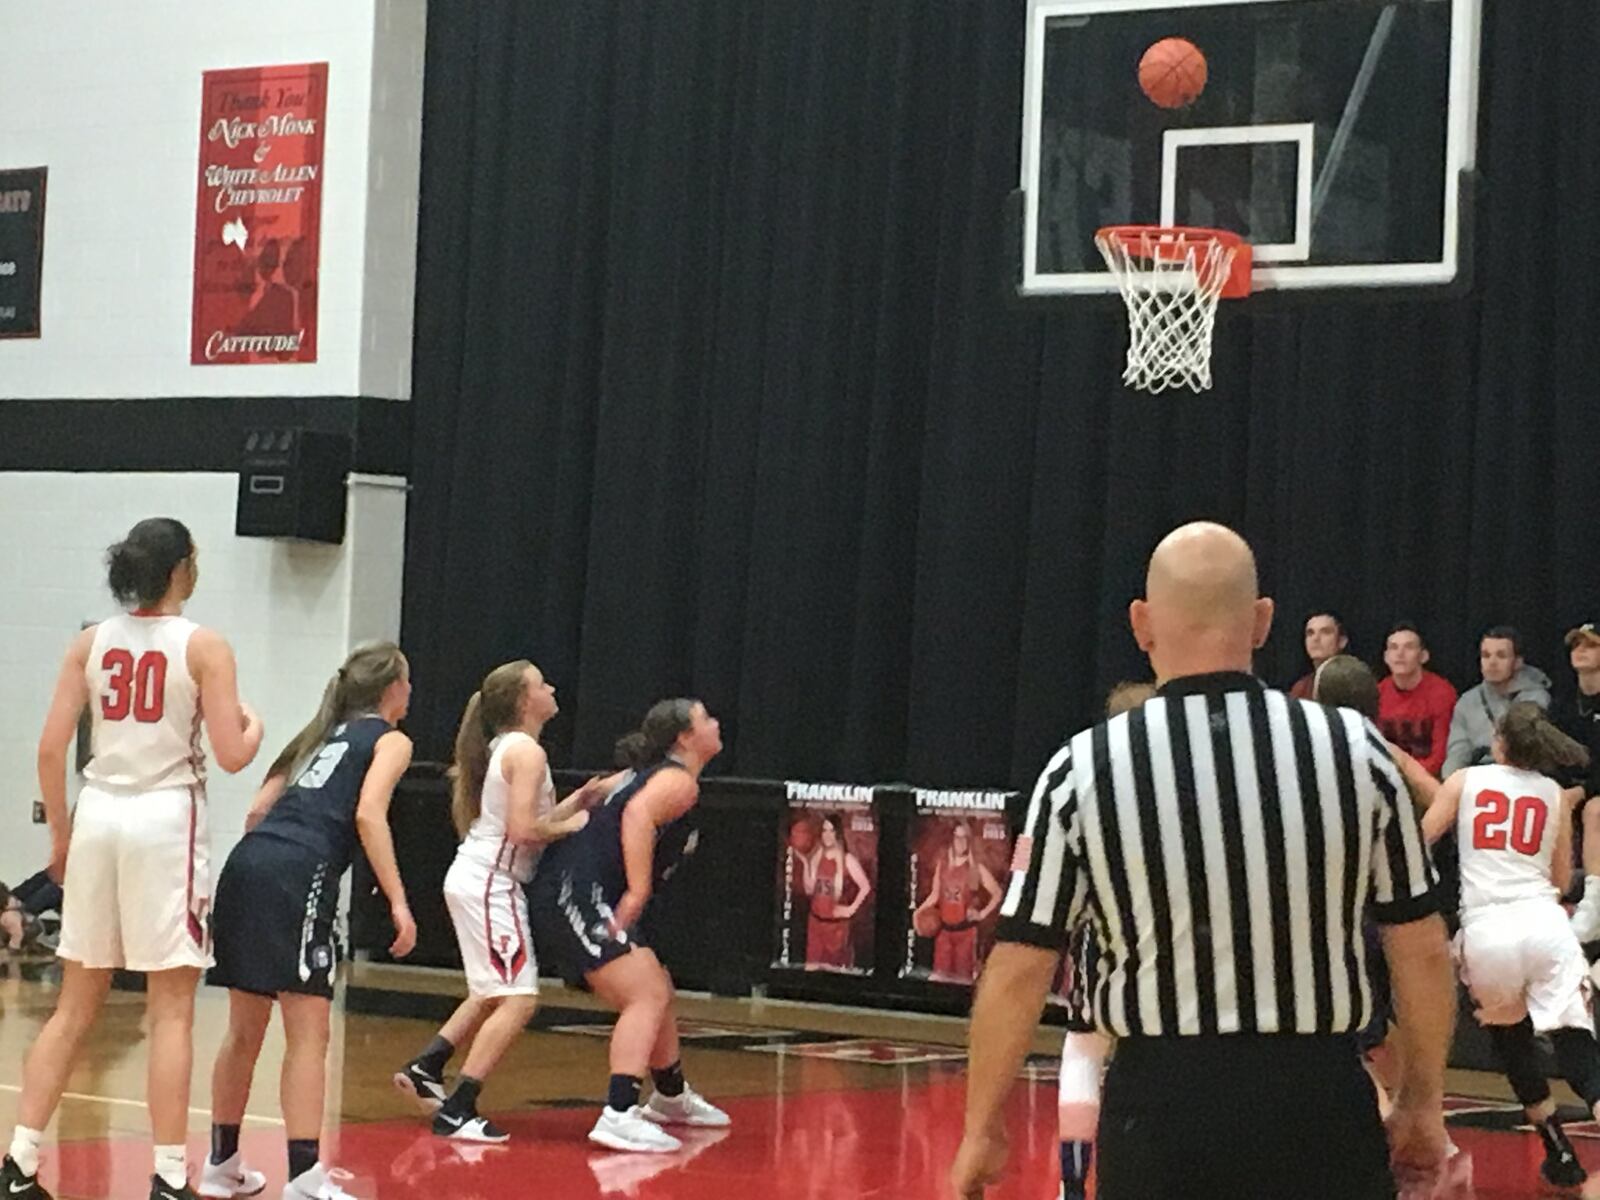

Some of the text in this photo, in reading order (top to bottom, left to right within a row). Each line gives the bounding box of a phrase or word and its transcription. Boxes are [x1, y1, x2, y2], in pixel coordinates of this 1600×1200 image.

[215, 186, 304, 213] CHEVROLET
[101, 648, 168, 723] 30
[786, 782, 874, 803] FRANKLIN
[915, 789, 1006, 810] FRANKLIN
[1473, 789, 1548, 856] 20
